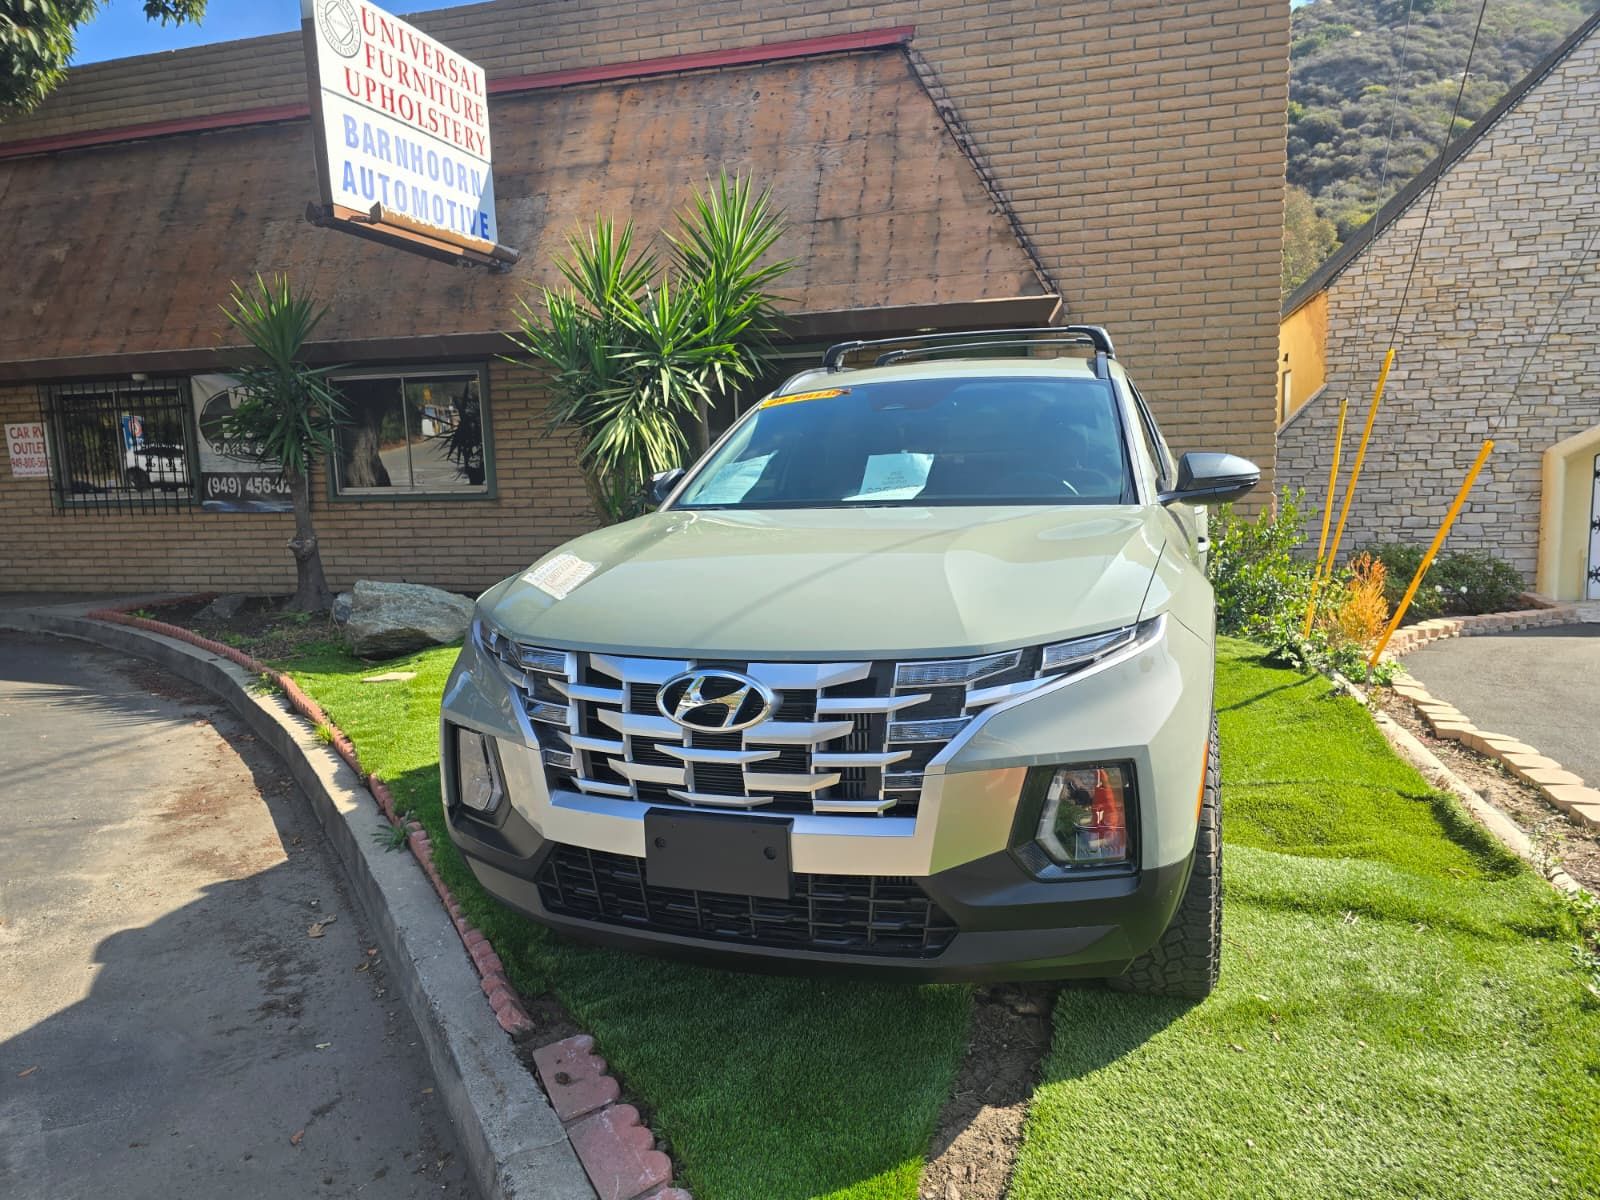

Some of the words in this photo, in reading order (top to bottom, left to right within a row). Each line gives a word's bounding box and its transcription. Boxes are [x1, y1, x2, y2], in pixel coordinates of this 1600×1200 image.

[360, 4, 483, 98] UNIVERSAL
[364, 42, 485, 128] FURNITURE
[343, 66, 486, 157] UPHOLSTERY
[342, 113, 483, 199] BARNHOORN
[342, 160, 490, 241] AUTOMOTIVE
[9, 426, 30, 440] CAR
[207, 476, 242, 498] (949)
